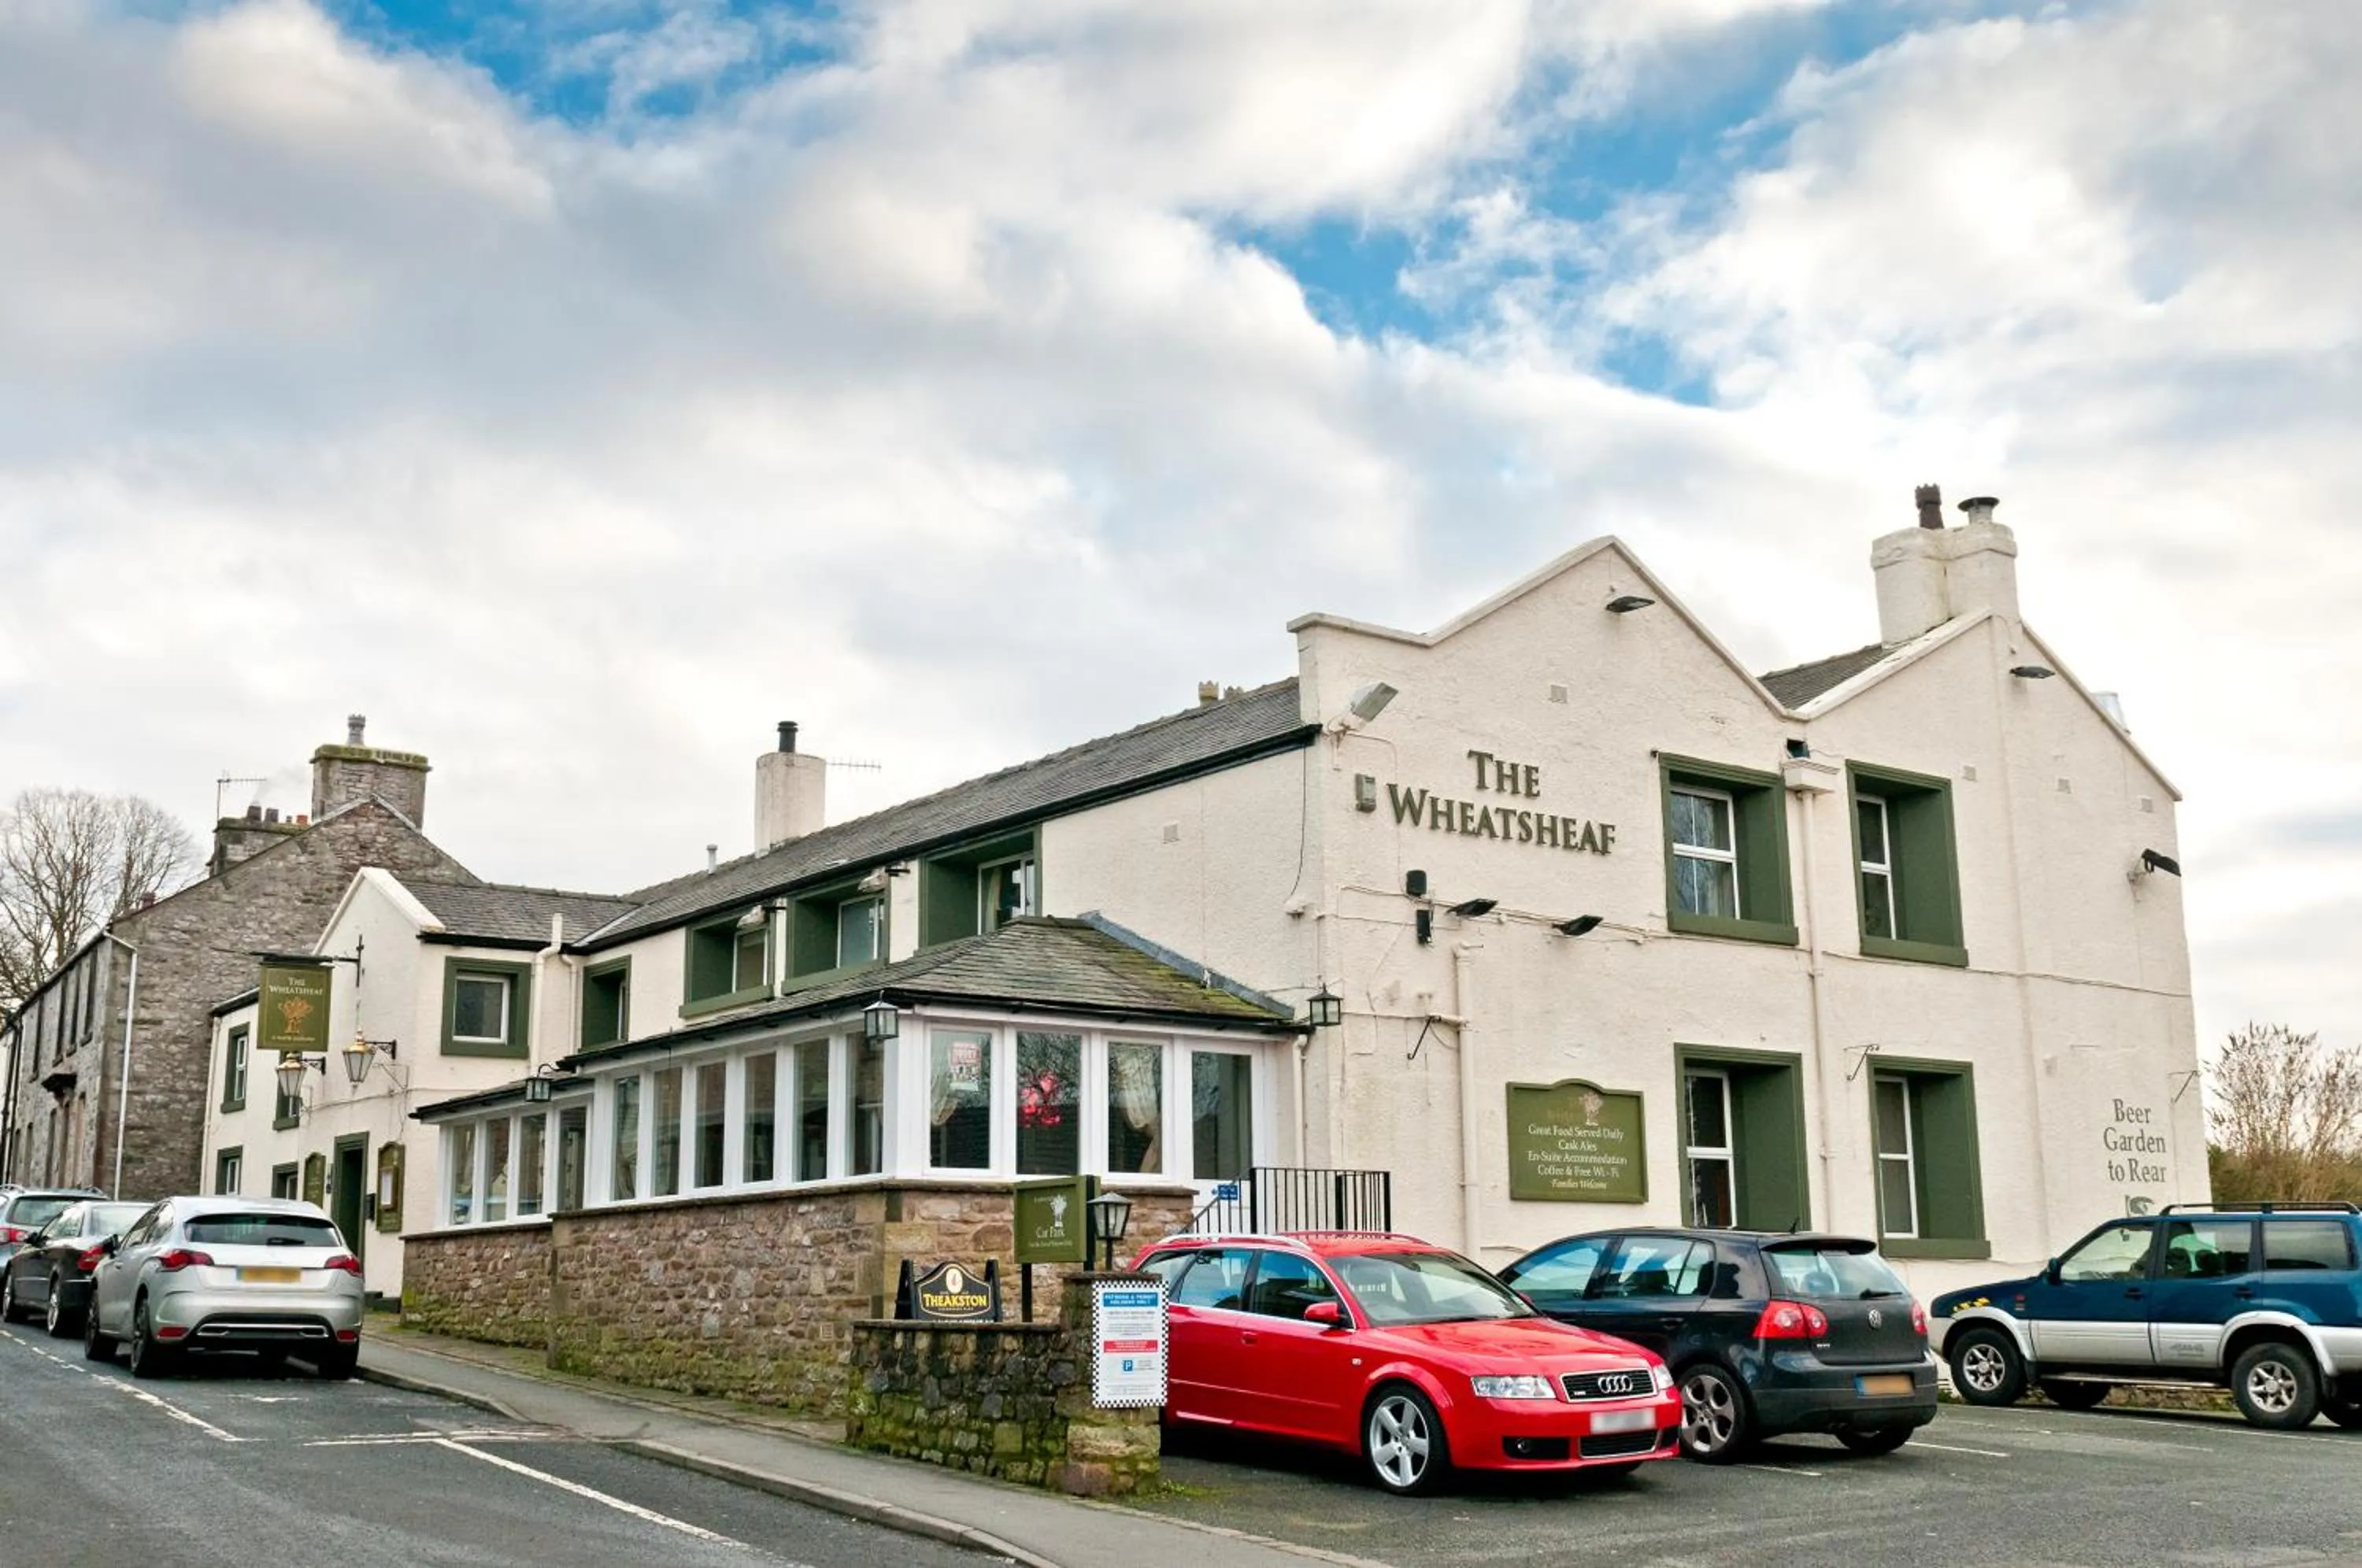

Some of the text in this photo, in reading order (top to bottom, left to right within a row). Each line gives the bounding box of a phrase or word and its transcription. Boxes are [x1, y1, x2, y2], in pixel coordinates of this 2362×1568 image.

[1467, 749, 1542, 799] THE
[1386, 782, 1616, 856] WHEATSHEAF
[269, 986, 324, 997] WHEATSHEAF
[2112, 1099, 2152, 1124] Beer
[1528, 1124, 1624, 1142] Great Food Served Daily
[2103, 1126, 2167, 1153] Garden
[1558, 1139, 1597, 1152] Cask Ales
[1563, 1154, 1627, 1166] Accommodation
[1538, 1164, 1564, 1176] Coffee
[1565, 1166, 1573, 1176] &
[1574, 1167, 1592, 1178] Free
[2108, 1158, 2167, 1183] to Rear
[923, 1293, 987, 1307] THEAKSTON
